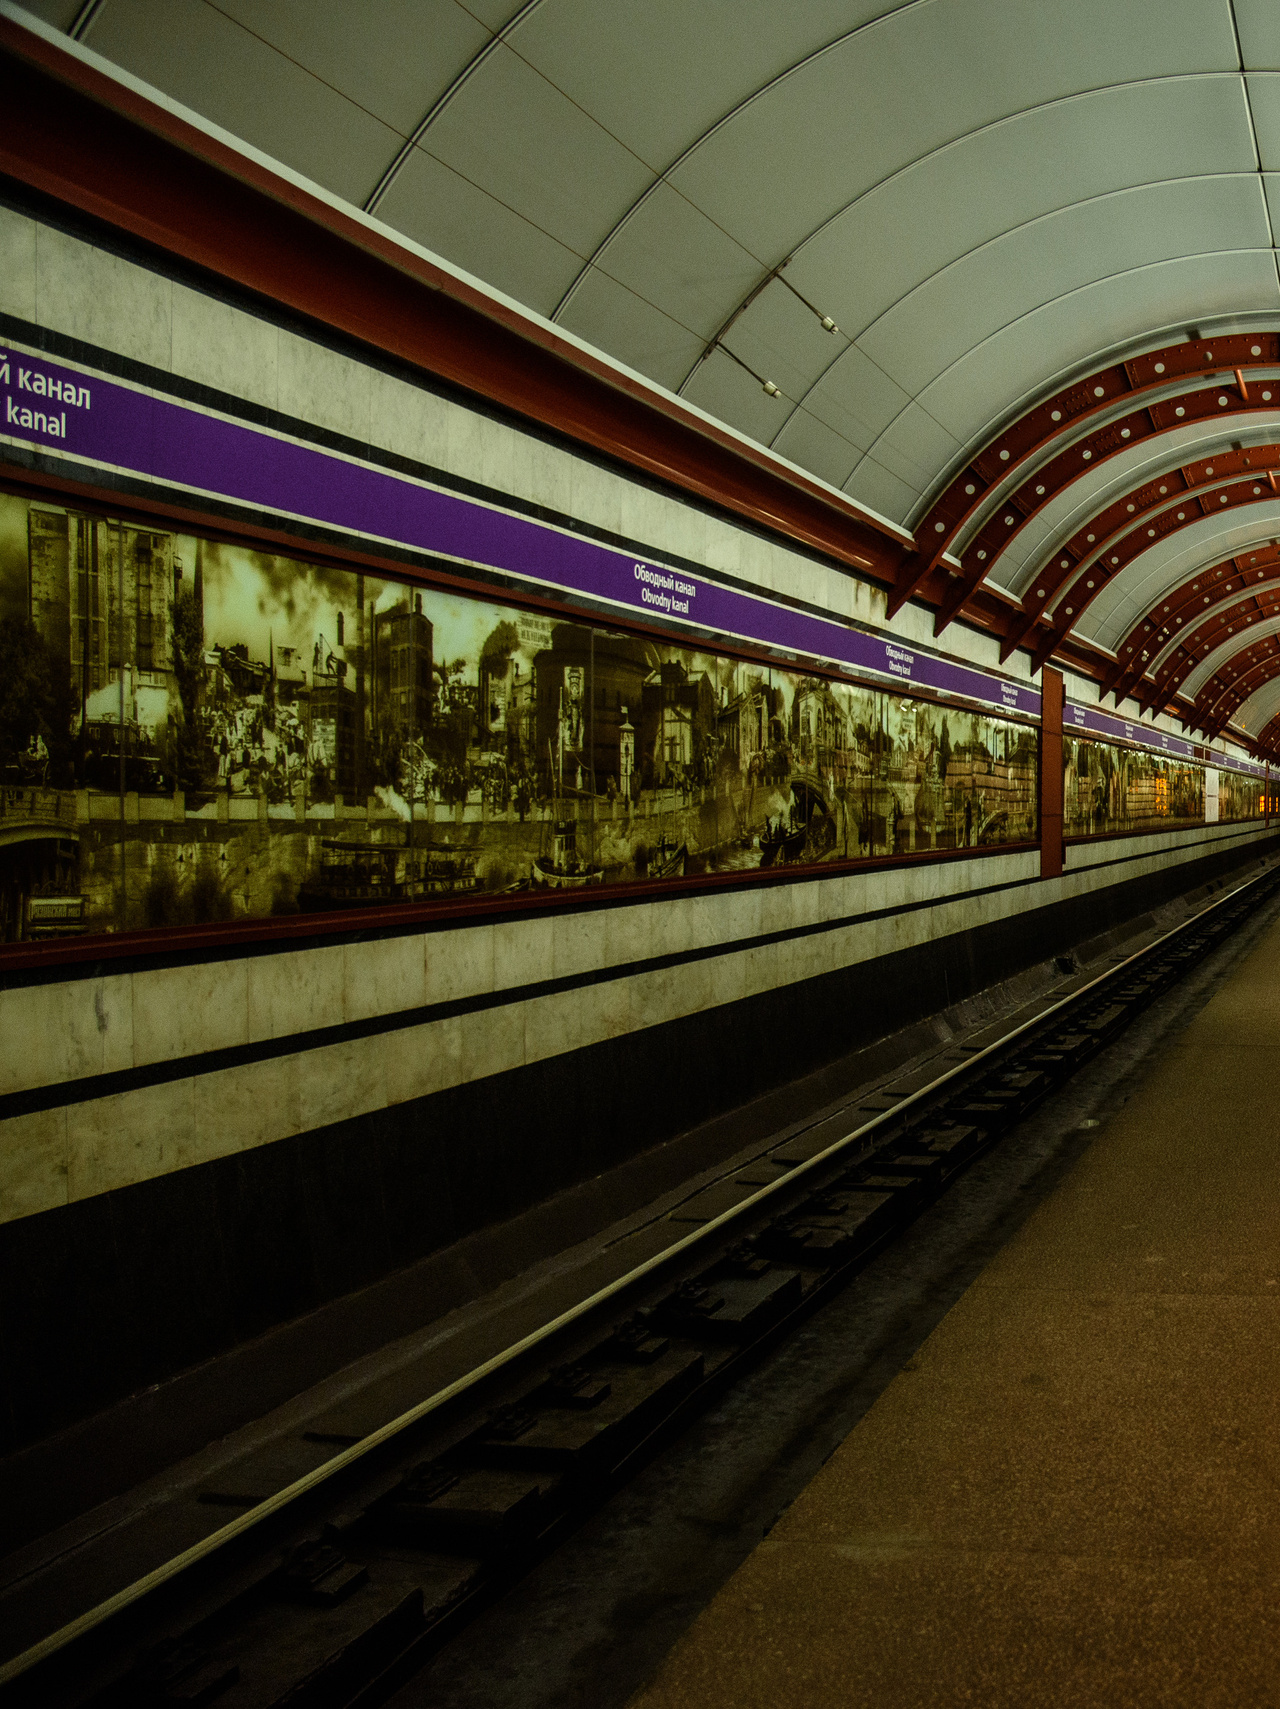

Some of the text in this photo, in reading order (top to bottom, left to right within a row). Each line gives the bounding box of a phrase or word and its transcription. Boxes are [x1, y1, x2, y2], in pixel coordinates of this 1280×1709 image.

[18, 367, 91, 410] канал
[7, 395, 66, 438] kanal
[634, 563, 696, 597] Обводный канал
[641, 587, 689, 614] Obvodny kanal
